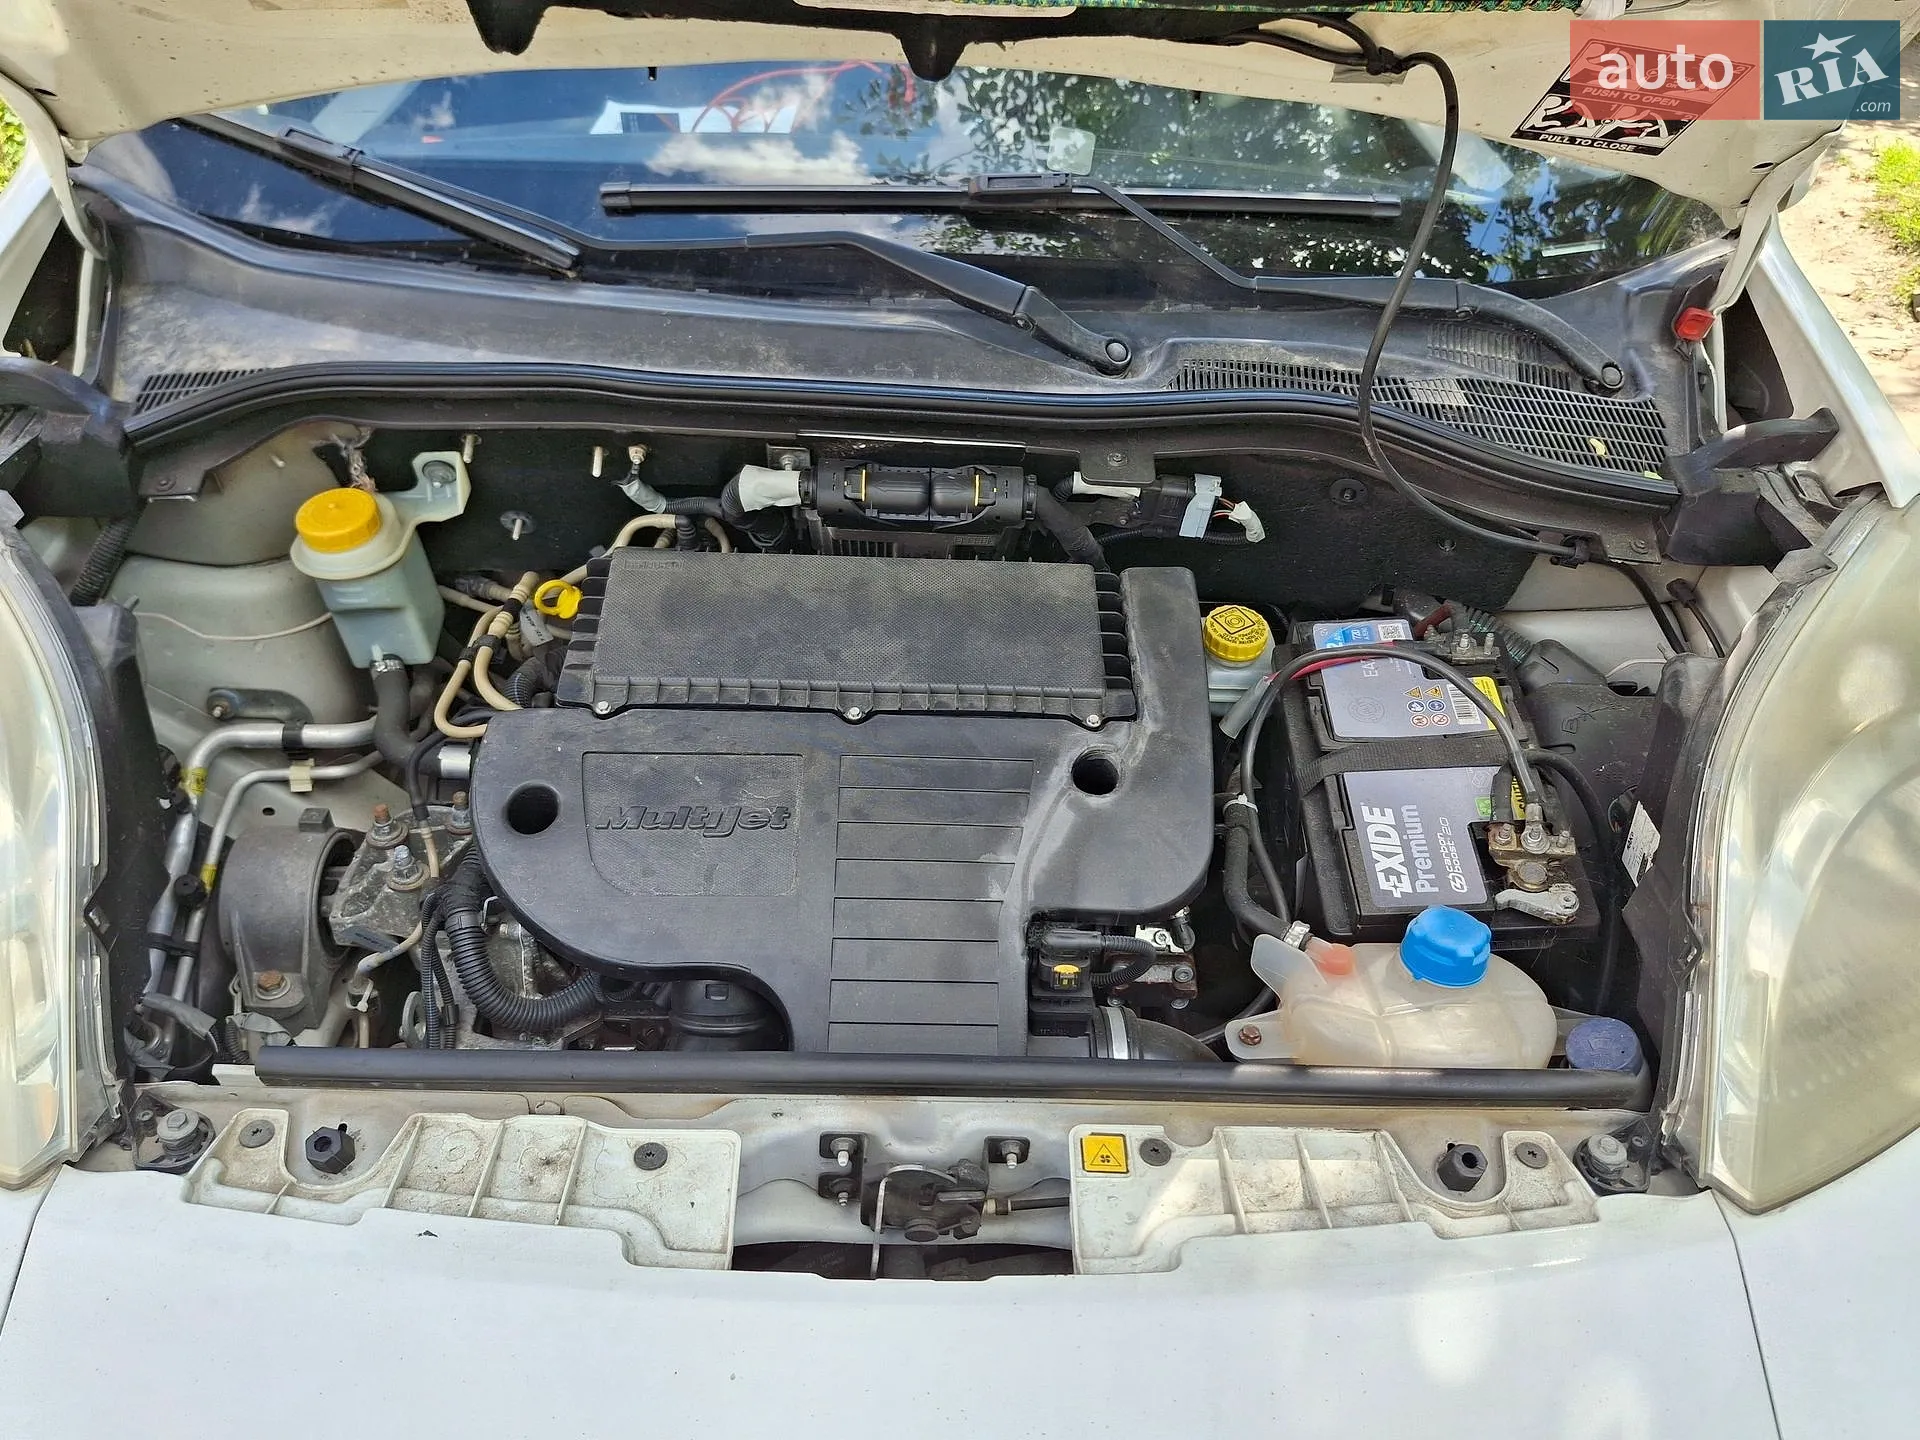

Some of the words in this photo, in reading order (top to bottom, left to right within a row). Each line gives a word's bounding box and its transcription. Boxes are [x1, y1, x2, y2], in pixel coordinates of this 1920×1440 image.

[1582, 87, 1621, 99] PUSH
[1621, 90, 1643, 101] TO
[1642, 93, 1681, 107] OPEN
[1538, 134, 1570, 144] PULL
[1575, 137, 1592, 147] TO
[1593, 139, 1637, 152] CLOSE
[1361, 805, 1413, 898] EXIDE
[1400, 804, 1439, 894] Premium
[1437, 832, 1453, 873] carbon
[1446, 840, 1463, 873] boost
